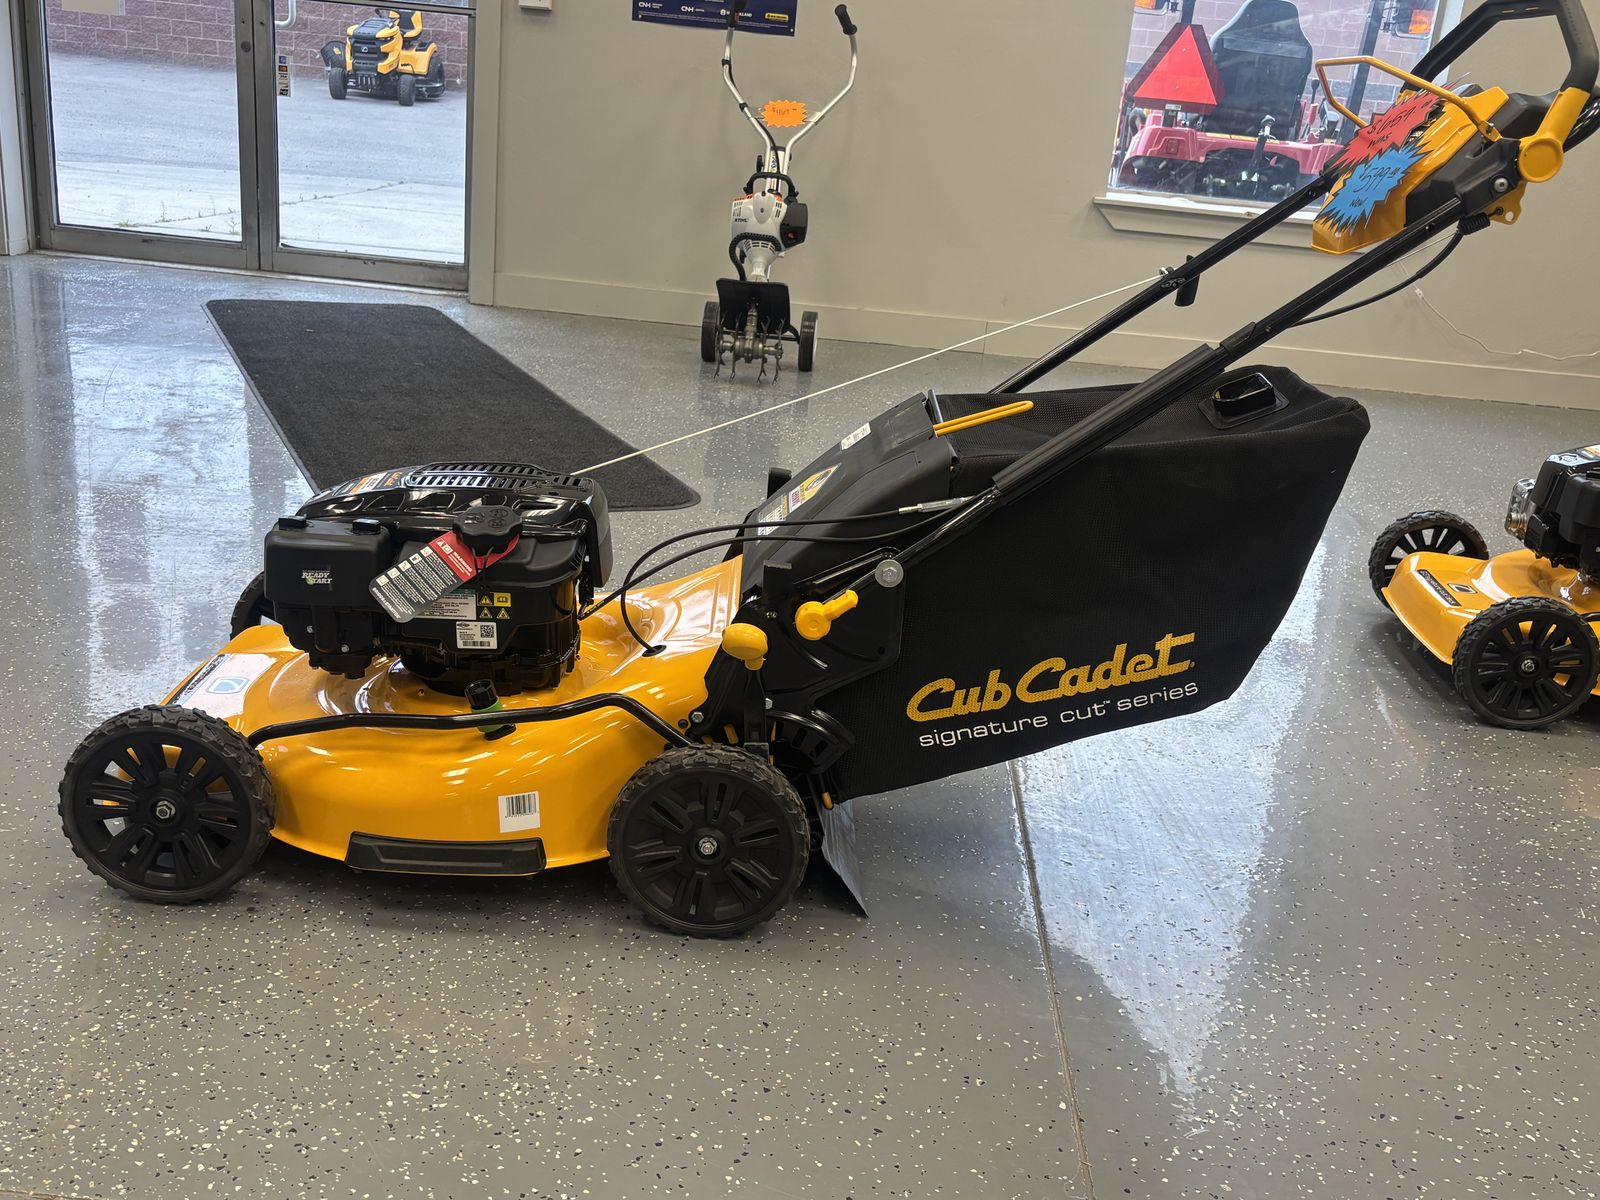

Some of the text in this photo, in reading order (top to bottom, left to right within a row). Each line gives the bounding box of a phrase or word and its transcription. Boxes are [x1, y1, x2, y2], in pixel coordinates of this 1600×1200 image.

[680, 5, 694, 13] CNH
[1349, 196, 1369, 208] NOW
[906, 632, 1196, 722] Cub Cadet
[918, 714, 1048, 749] signature
[1116, 680, 1199, 711] series
